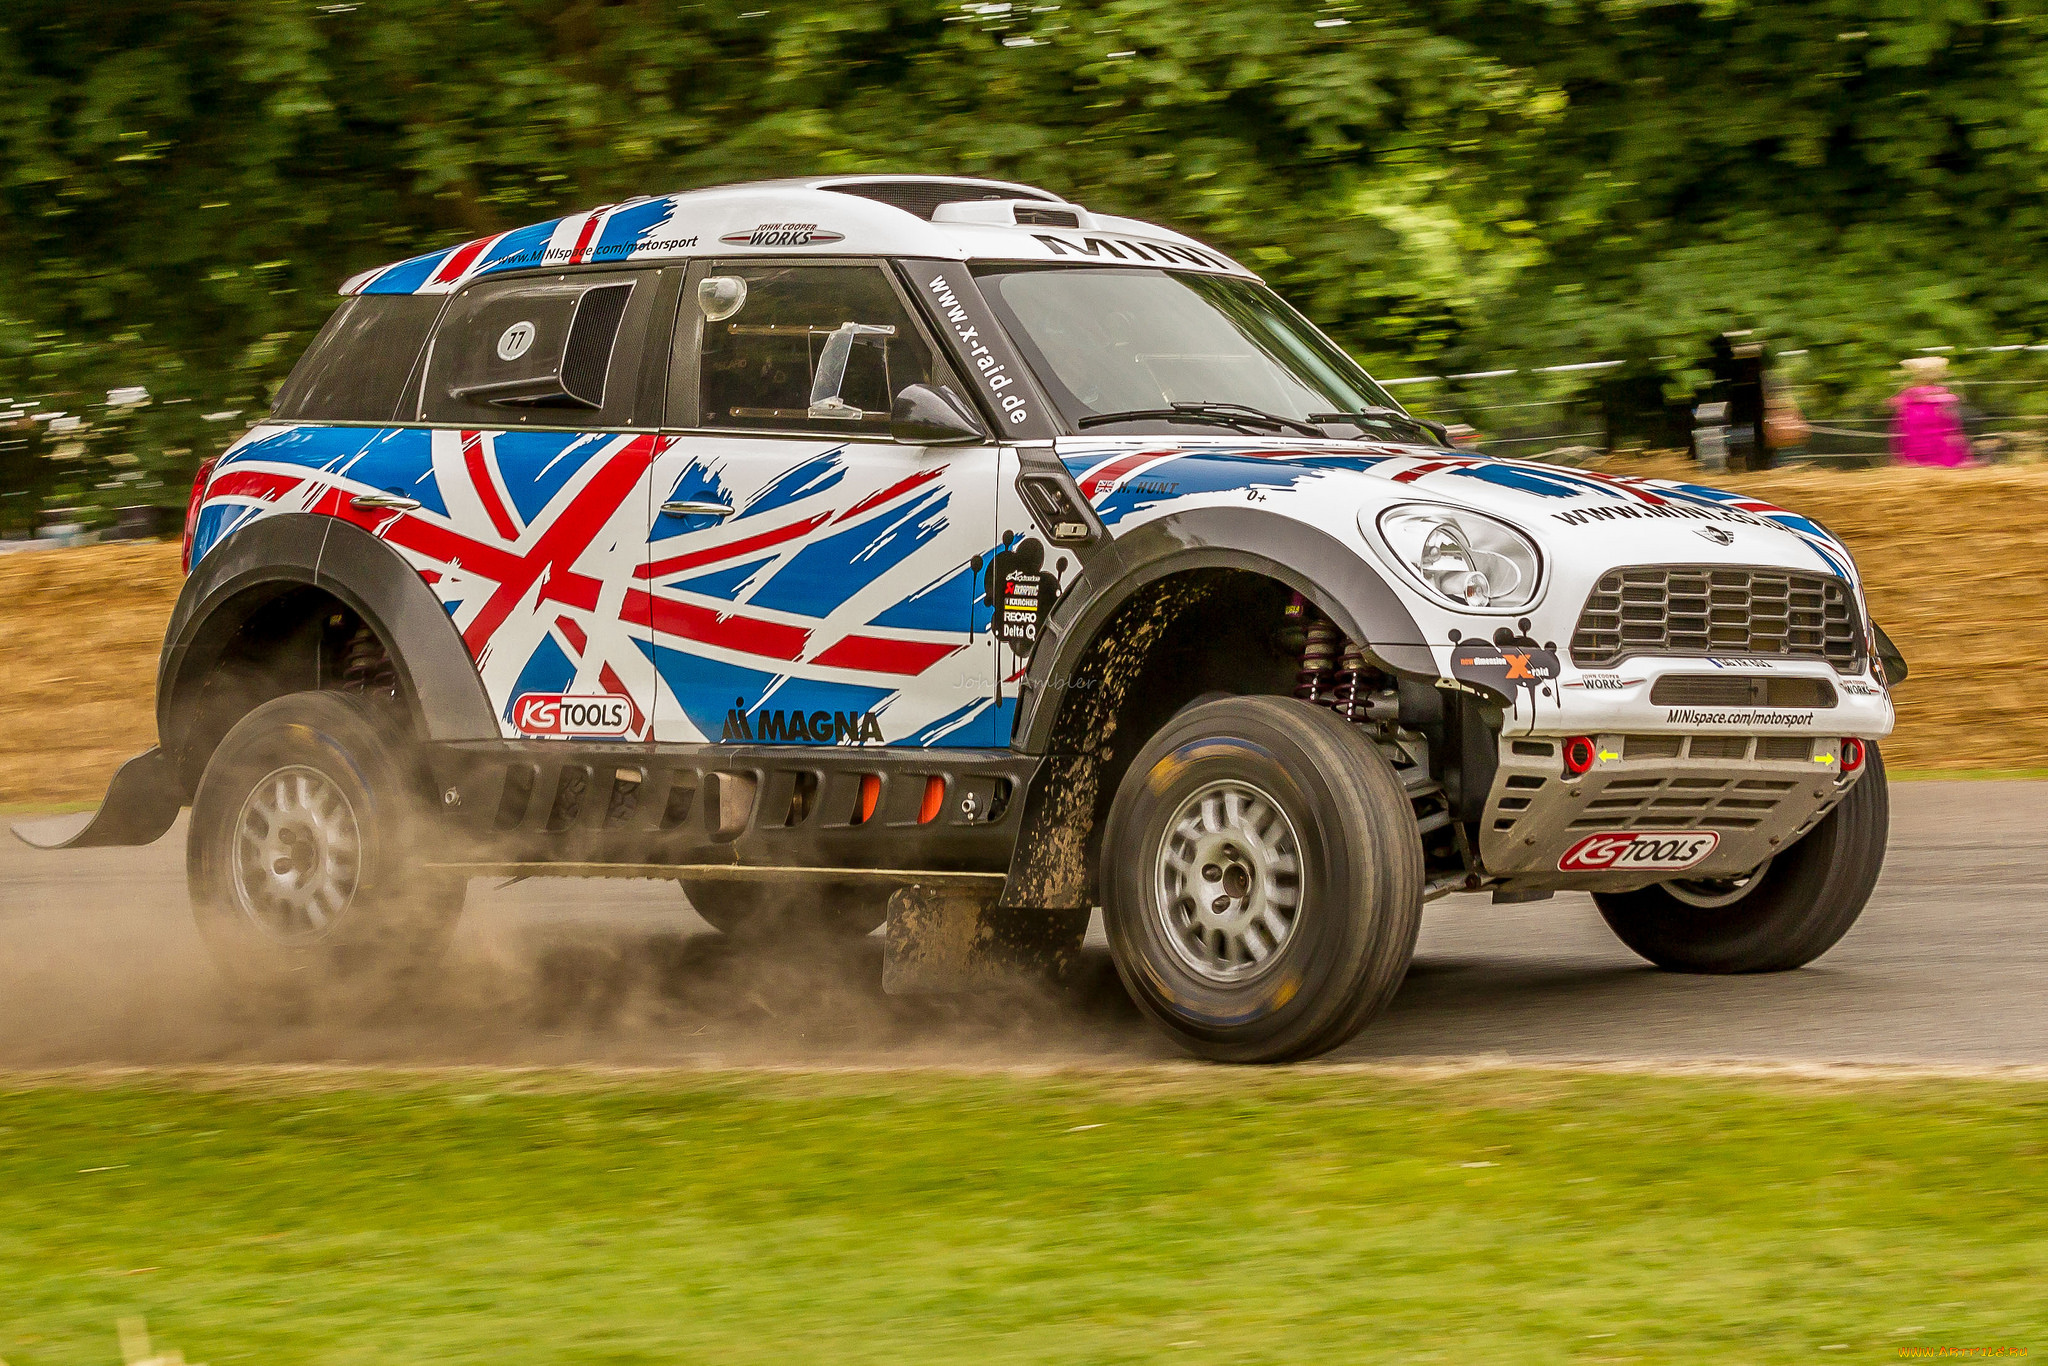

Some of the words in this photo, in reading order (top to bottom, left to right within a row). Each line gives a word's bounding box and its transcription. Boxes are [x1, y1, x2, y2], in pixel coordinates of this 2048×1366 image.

[782, 223, 818, 231] COOPER
[749, 231, 814, 246] WORKS
[1030, 234, 1229, 270] MINI
[506, 330, 527, 351] 77
[928, 275, 1028, 425] www.x-raid.de
[1136, 481, 1180, 495] HUNT
[1003, 611, 1037, 623] RECARO
[1003, 623, 1024, 637] Delta
[1583, 679, 1624, 689] WORKS
[560, 704, 623, 727] TOOLS
[1666, 709, 1814, 728] MINIspace.com/motorsport
[757, 709, 885, 742] MAGNA
[1621, 840, 1707, 862] TOOLS
